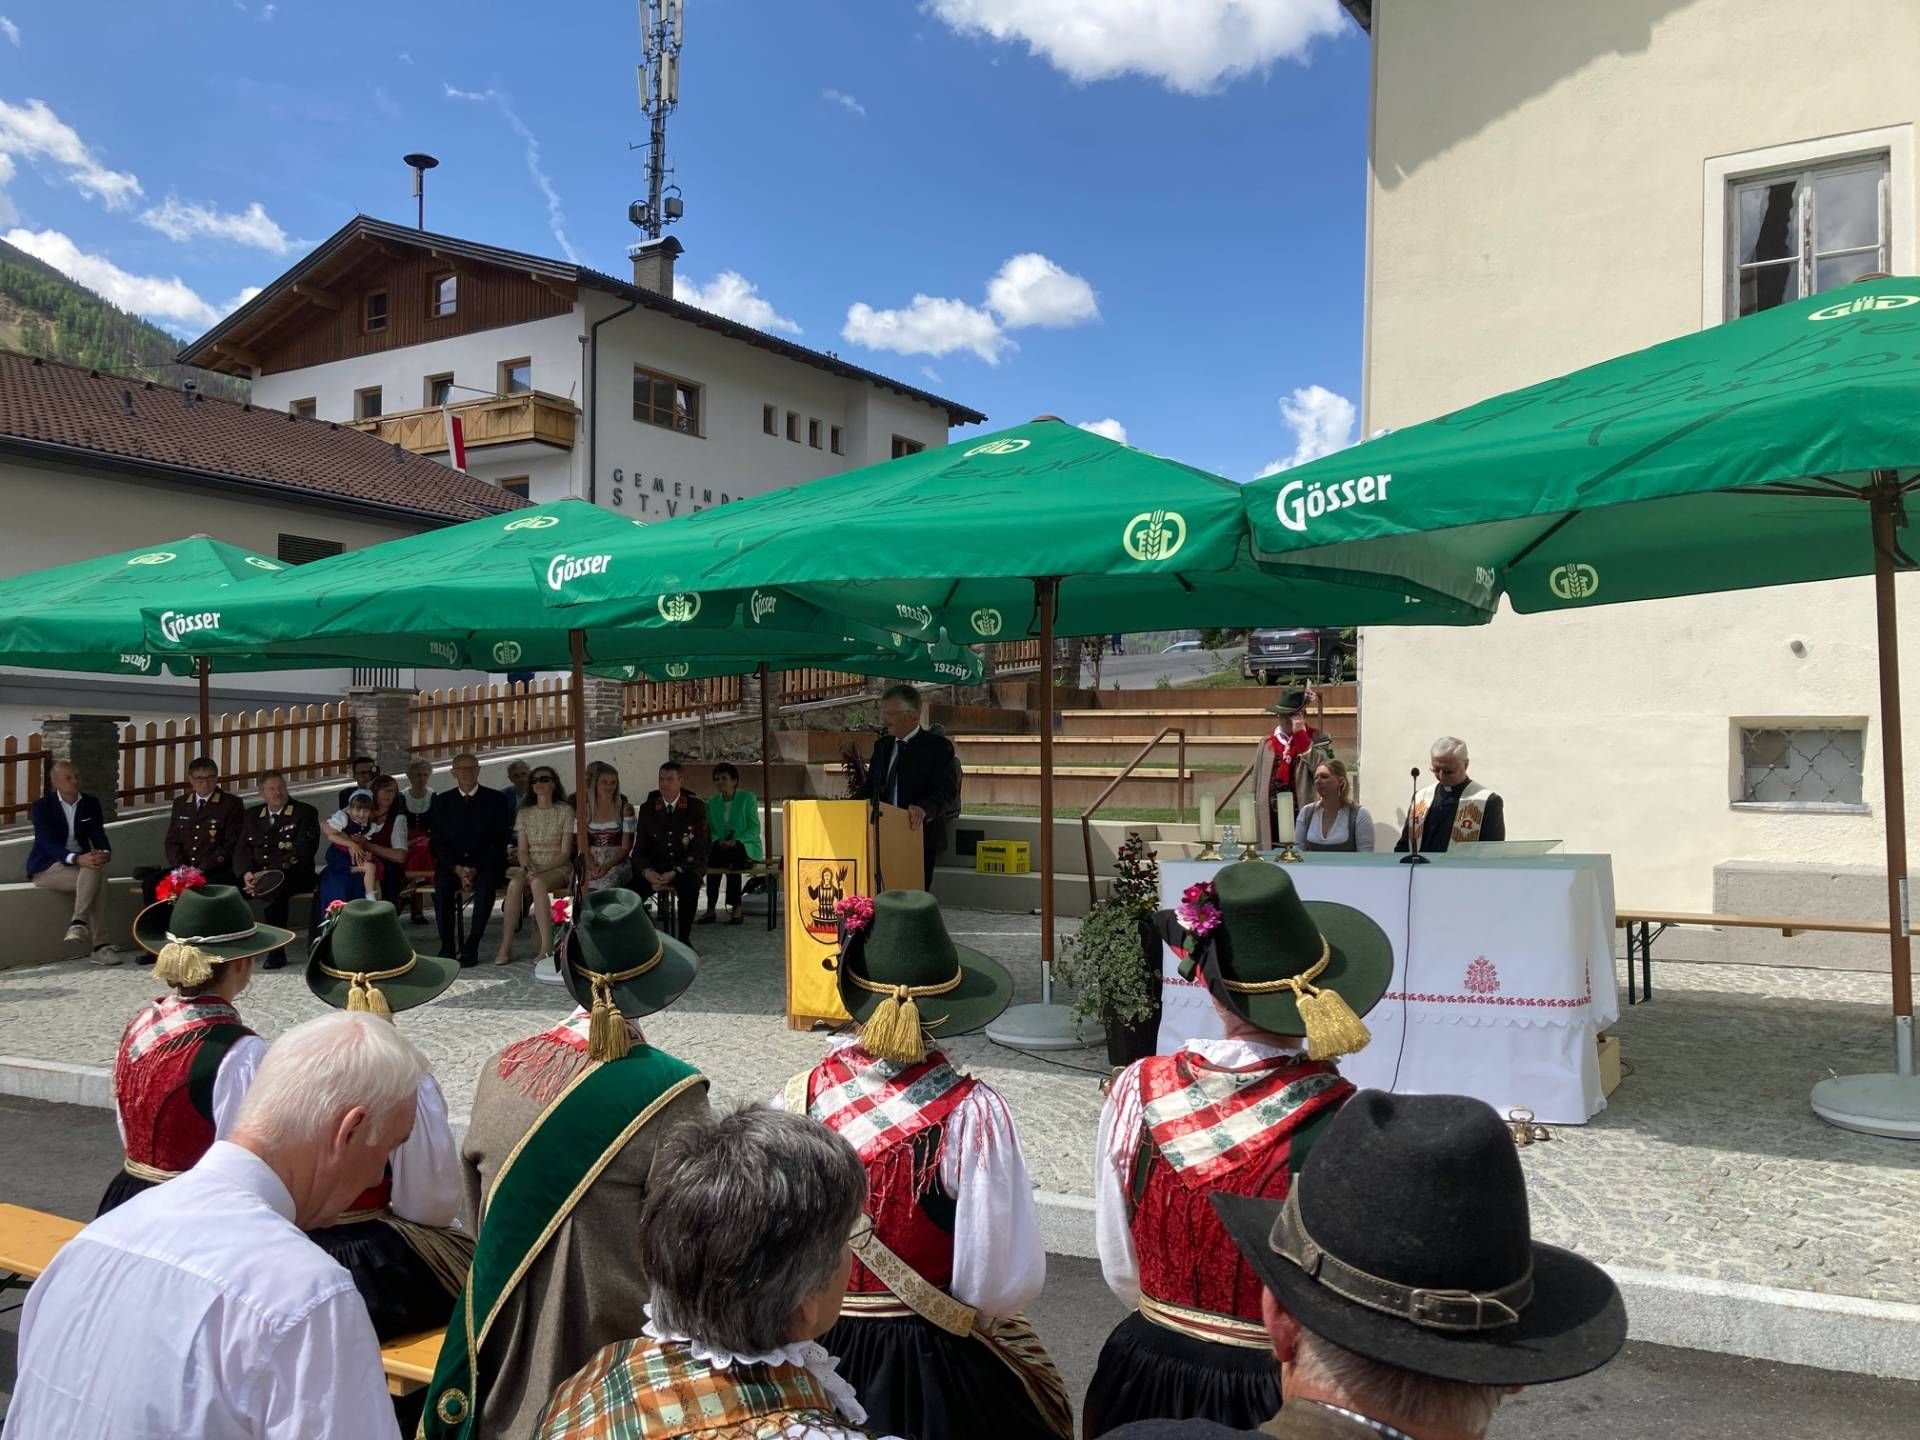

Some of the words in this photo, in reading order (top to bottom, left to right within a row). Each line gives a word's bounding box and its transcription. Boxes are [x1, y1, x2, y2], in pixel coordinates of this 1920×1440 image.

[613, 468, 744, 506] GEMEIND
[1276, 474, 1392, 531] Gösser
[547, 554, 612, 590] Gösser
[751, 589, 777, 624] Gösser
[161, 611, 221, 643] Gösser
